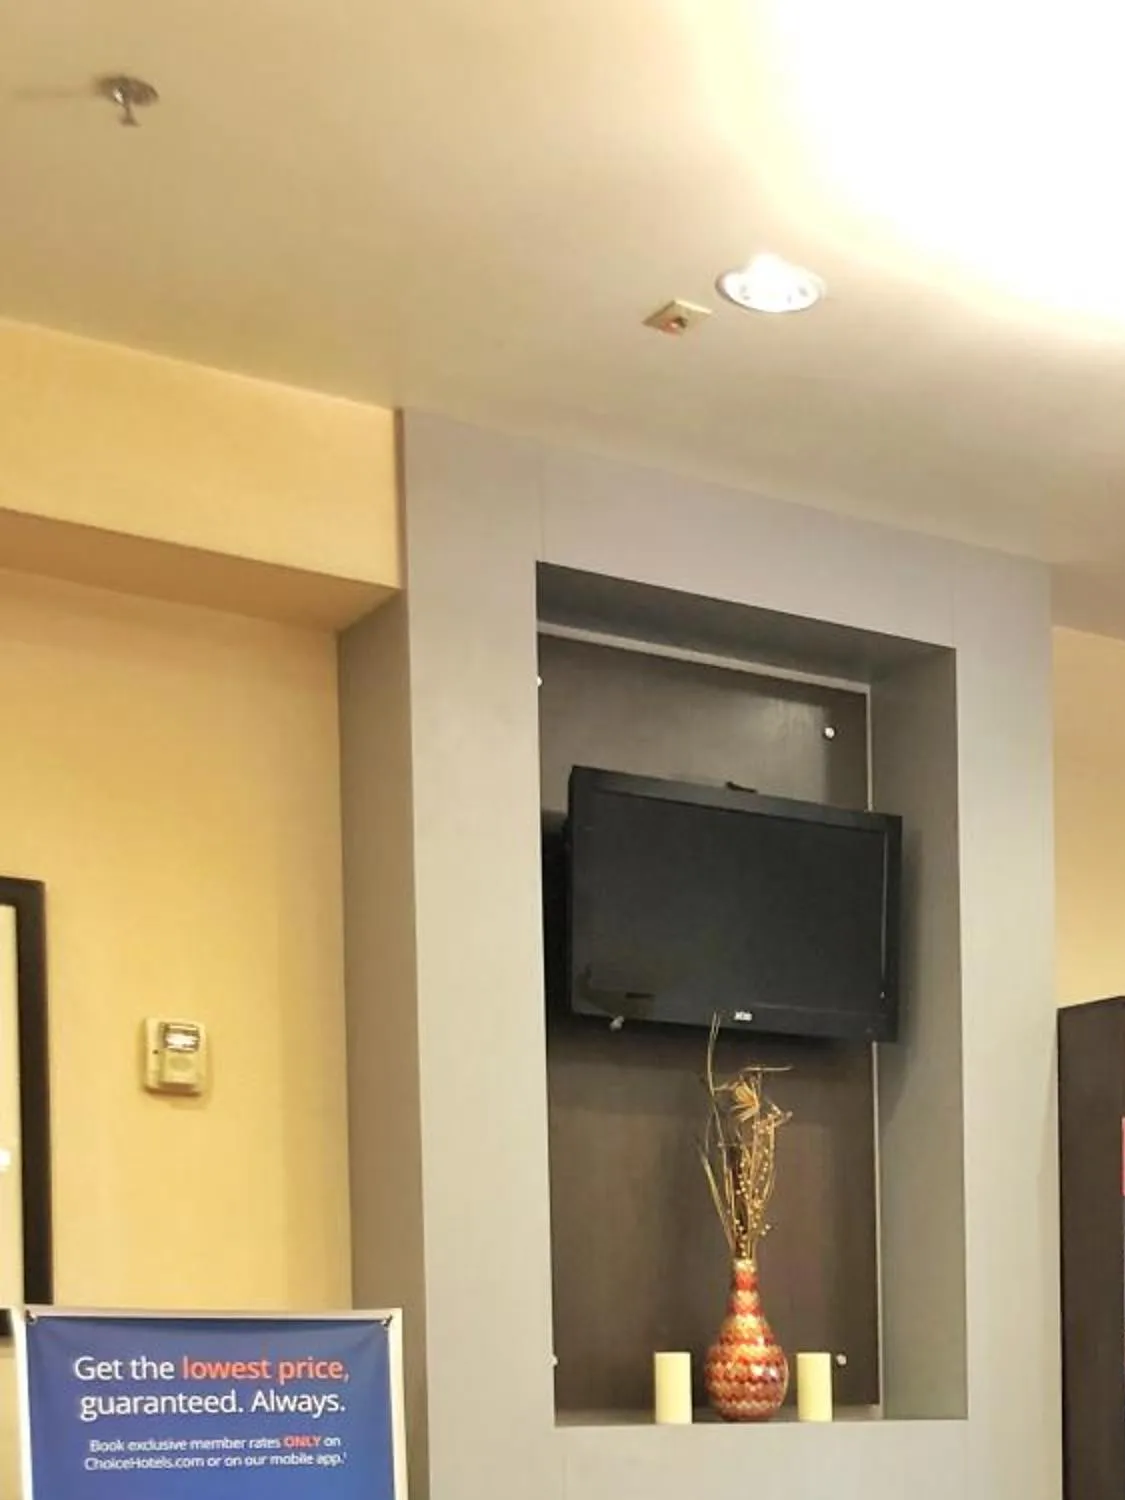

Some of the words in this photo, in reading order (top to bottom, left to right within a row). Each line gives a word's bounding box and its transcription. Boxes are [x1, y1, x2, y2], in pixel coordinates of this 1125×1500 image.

[75, 1355, 123, 1380] Get
[130, 1355, 175, 1380] the
[183, 1355, 271, 1380] lowest
[280, 1355, 349, 1386] price,
[80, 1388, 244, 1421] guaranteed.
[250, 1388, 346, 1418] Always.
[90, 1439, 125, 1452] Book
[127, 1438, 187, 1451] exclusive
[190, 1436, 246, 1450] member
[249, 1438, 281, 1449] rates
[283, 1435, 321, 1448] ONLY
[323, 1437, 341, 1447] on
[84, 1455, 205, 1470] ChoiceHotels.com
[206, 1456, 222, 1467] or
[224, 1456, 242, 1467] on
[244, 1455, 267, 1466] our
[269, 1452, 314, 1465] mobile
